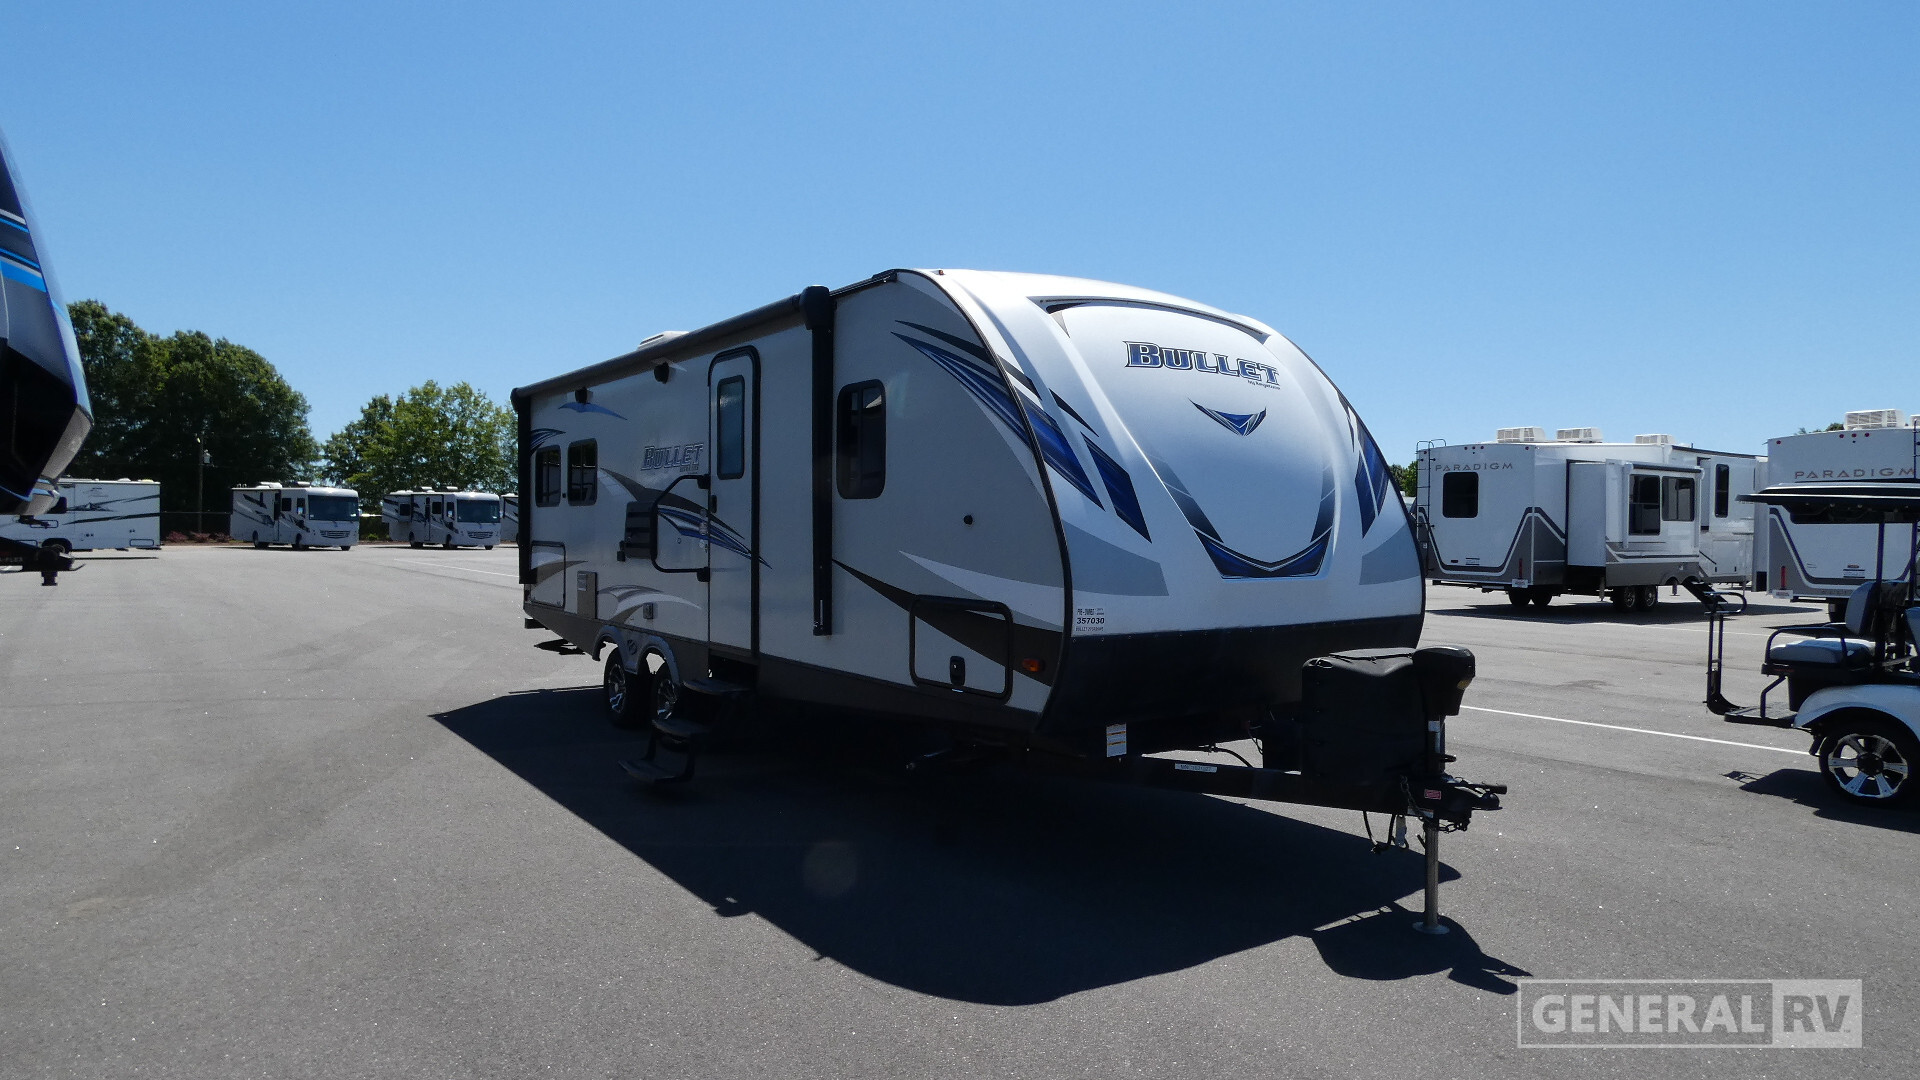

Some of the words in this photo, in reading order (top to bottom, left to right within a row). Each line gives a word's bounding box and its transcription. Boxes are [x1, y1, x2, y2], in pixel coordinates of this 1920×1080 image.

[1122, 340, 1280, 386] BULLET
[640, 442, 704, 471] BULLET
[1435, 462, 1513, 472] PARADIGM
[1794, 467, 1915, 480] PARADIGM
[1076, 617, 1105, 625] 357030
